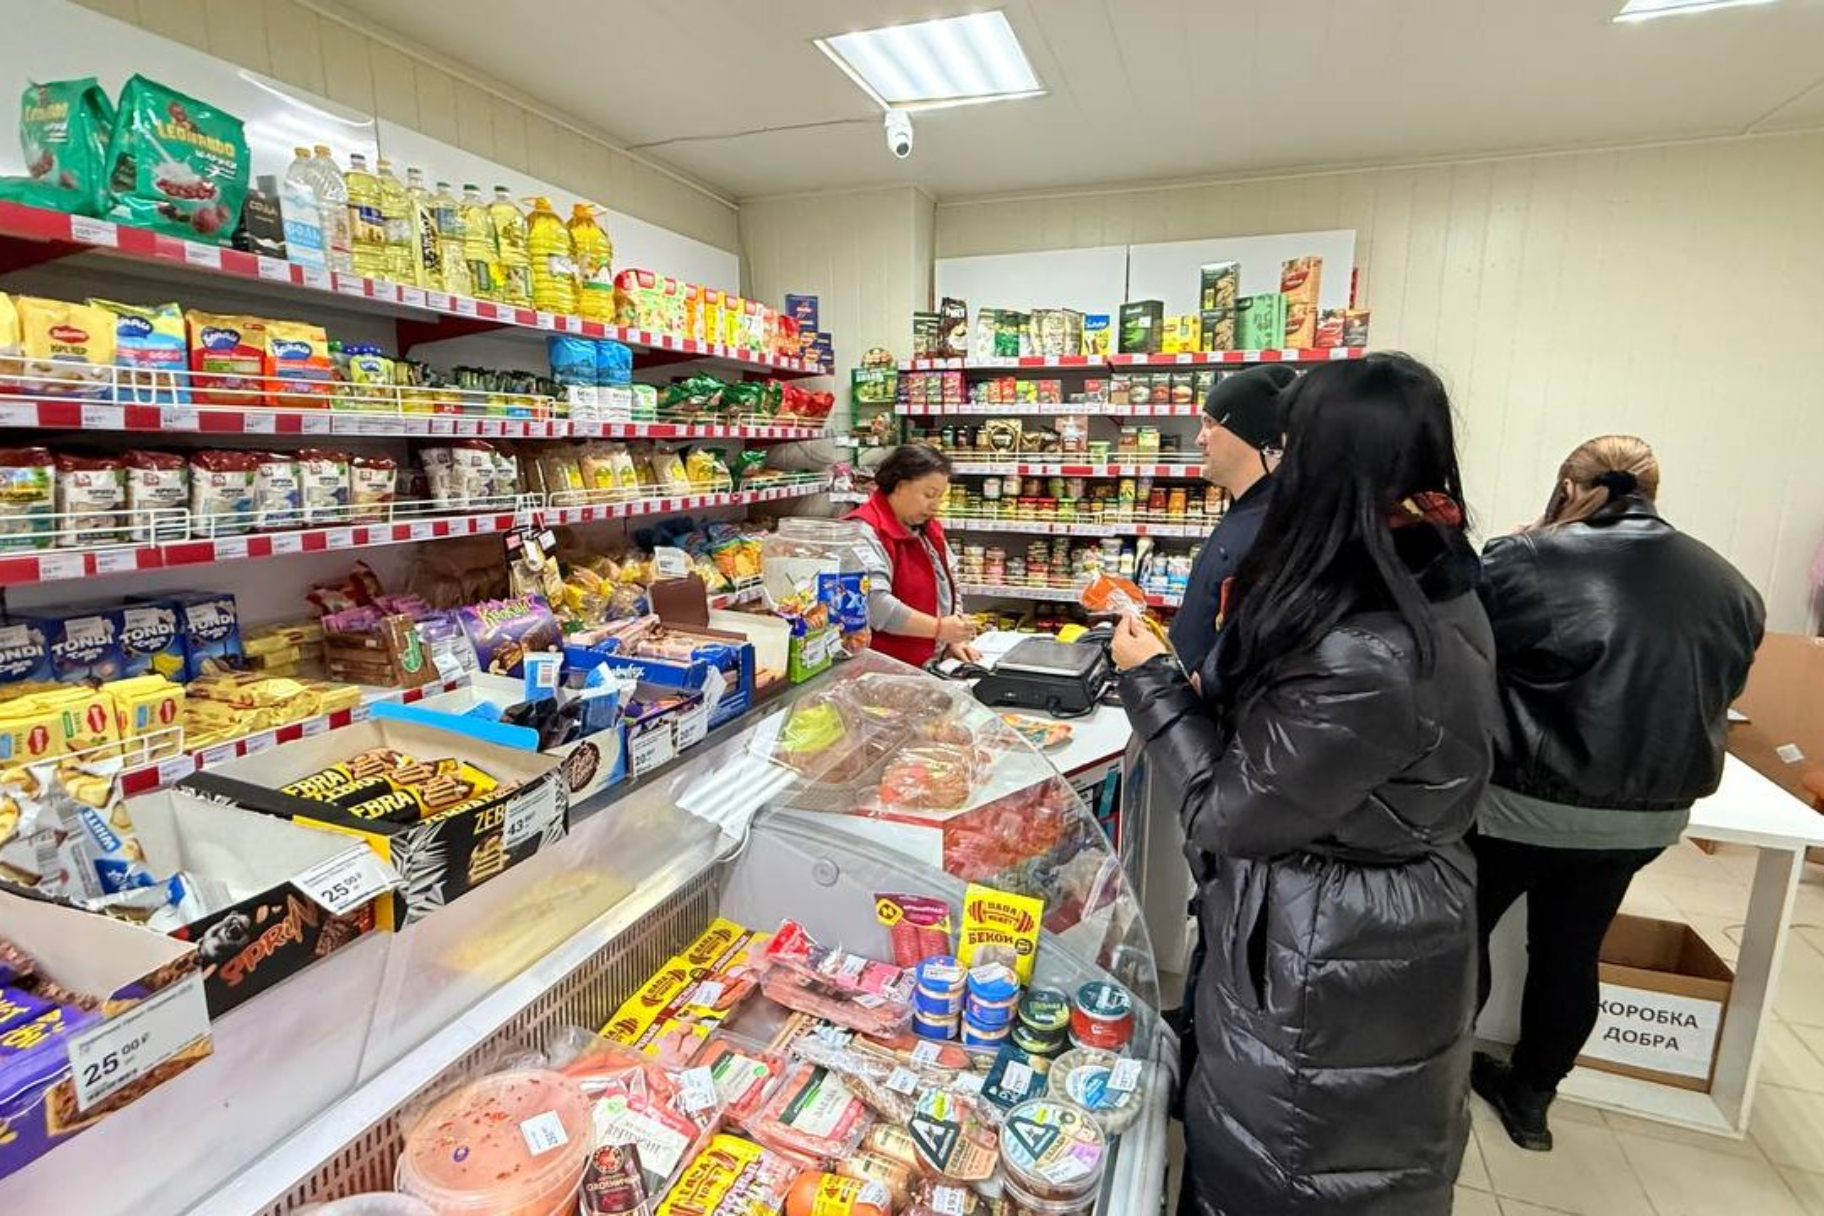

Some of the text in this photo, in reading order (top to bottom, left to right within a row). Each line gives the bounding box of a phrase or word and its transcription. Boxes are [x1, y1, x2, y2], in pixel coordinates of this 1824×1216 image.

[156, 118, 235, 157] LEONARDO
[119, 623, 175, 644] TONDI
[187, 614, 235, 633] TONDI
[51, 635, 113, 655] TONDI
[280, 769, 348, 800] EBRA
[347, 790, 416, 820] EBRA
[473, 801, 505, 836] ZEB
[321, 883, 349, 903] 25
[988, 901, 1018, 915] ПАПА
[968, 930, 1014, 944] БЕКОН
[1599, 1000, 1699, 1029] КОРОБКА
[1603, 1027, 1680, 1051] ДОБРА
[83, 1051, 119, 1087] 25
